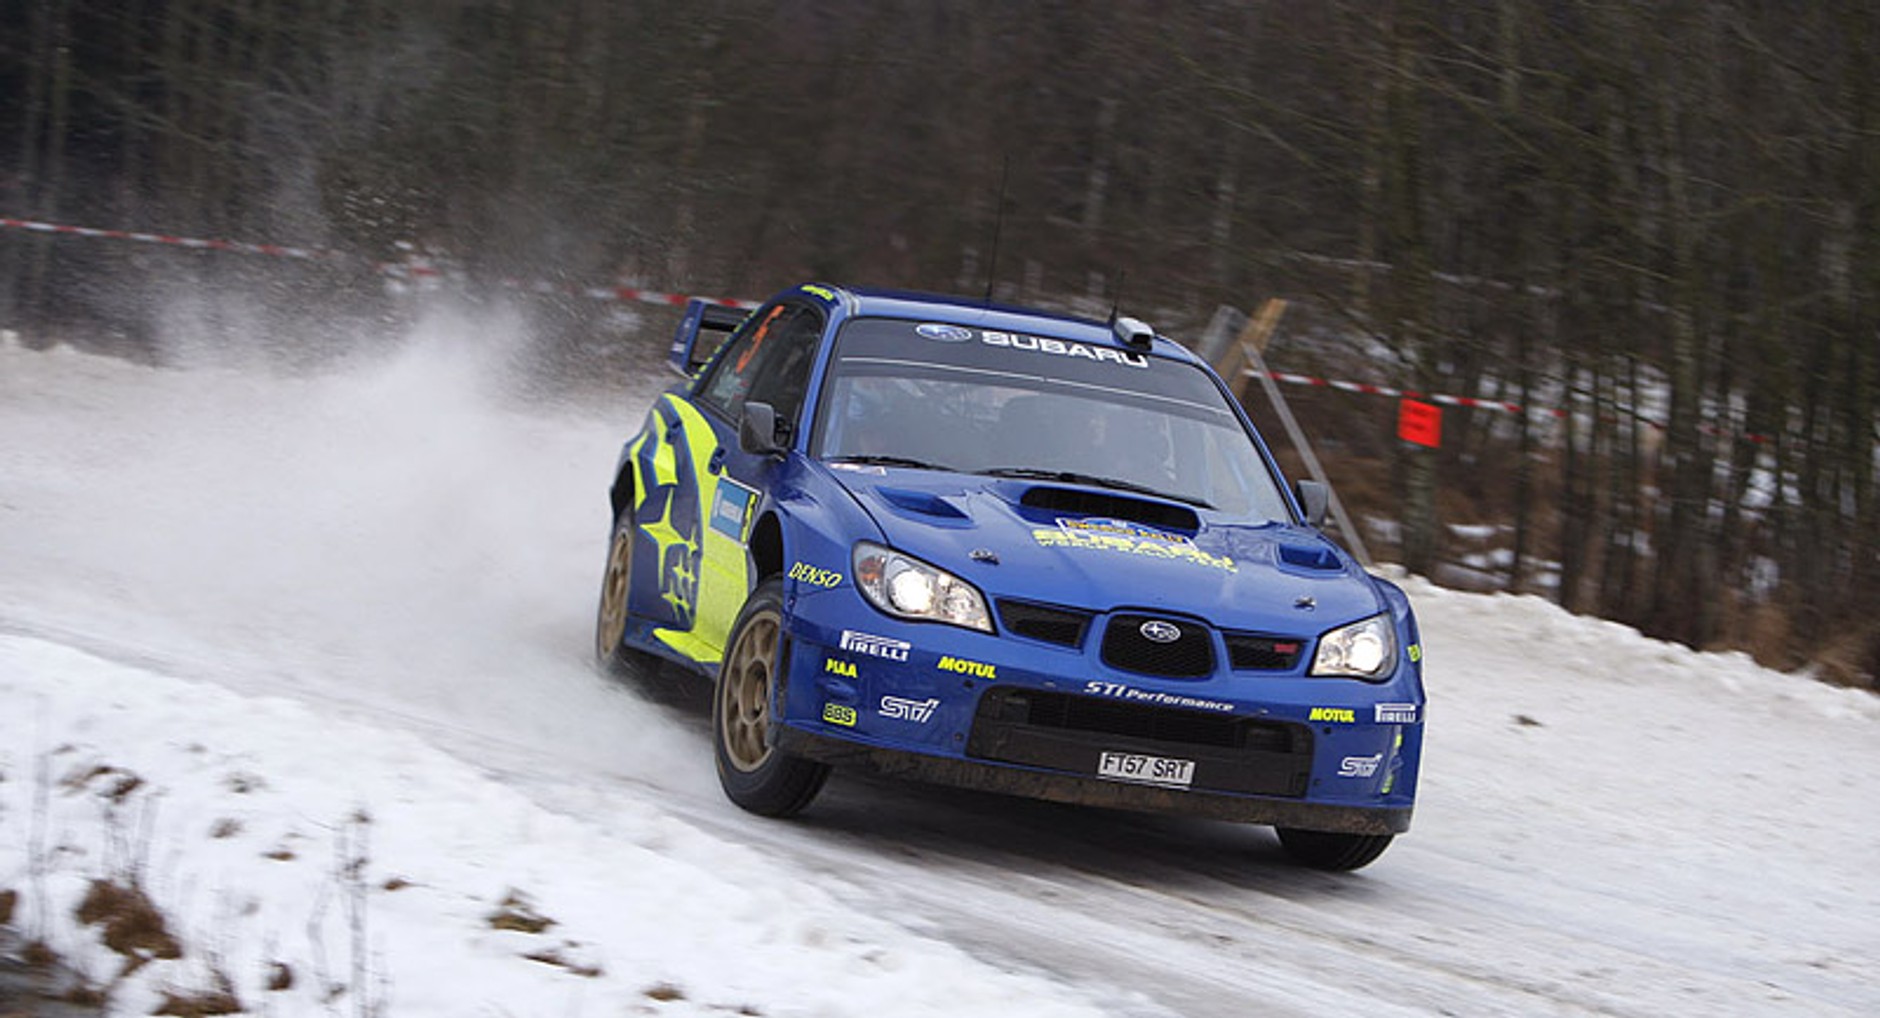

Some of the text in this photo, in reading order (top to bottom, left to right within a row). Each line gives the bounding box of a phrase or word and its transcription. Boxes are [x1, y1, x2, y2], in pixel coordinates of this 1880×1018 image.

[981, 331, 1149, 369] SUBARU
[788, 562, 843, 588] DENSO
[840, 630, 911, 662] PIRELLI
[825, 658, 858, 678] PIAA
[937, 656, 997, 679] MOTUL
[1084, 681, 1235, 712] STI Performance
[823, 703, 857, 725] BBS
[1309, 708, 1355, 723] MOTUL
[1375, 703, 1416, 723] PIRELLI
[1102, 754, 1189, 779] FT57 SRT
